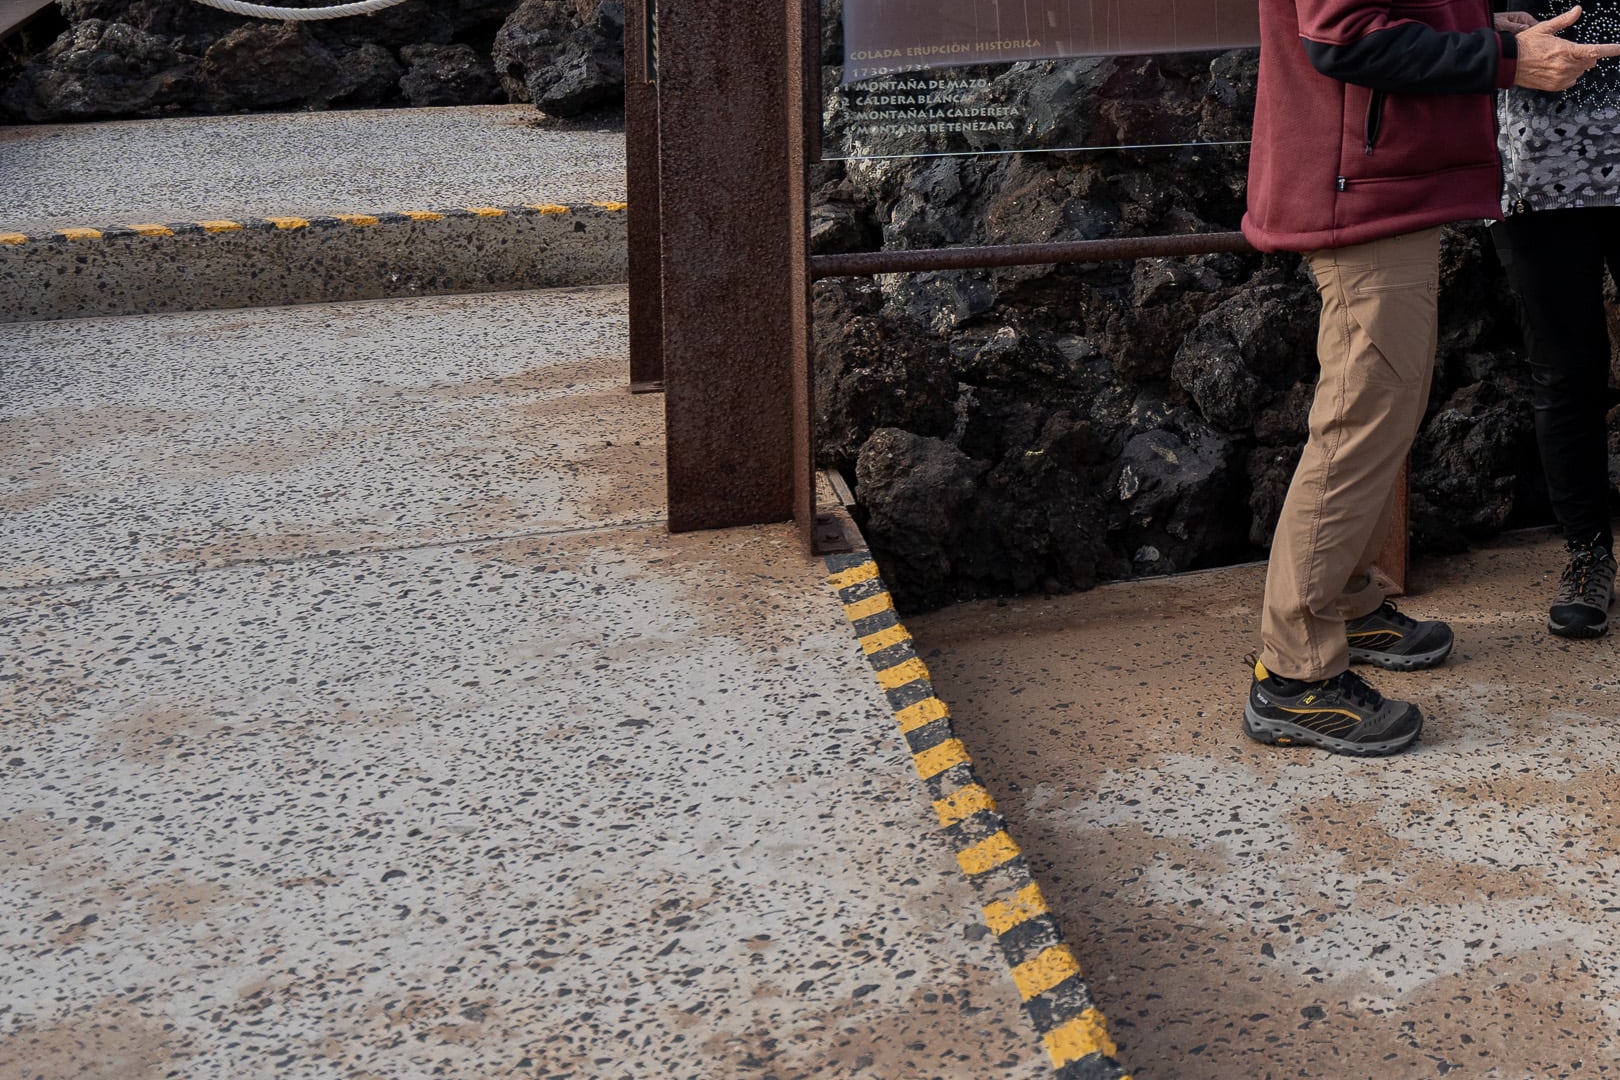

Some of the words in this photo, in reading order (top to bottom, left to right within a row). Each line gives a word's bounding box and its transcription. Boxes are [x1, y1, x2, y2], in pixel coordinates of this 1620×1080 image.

[850, 49, 902, 60] COLADA
[906, 42, 970, 57] ERUPCIÓN
[975, 39, 1041, 51] HISTÓRICA
[844, 82, 849, 92] 1
[855, 78, 927, 92] MONTAÑA
[929, 80, 945, 89] DE
[947, 78, 987, 88] MAZO
[843, 97, 850, 107] 2
[855, 95, 916, 106] CALDERA
[917, 94, 968, 104] BLANCA
[843, 111, 850, 121] 3
[856, 107, 927, 120] MONTAÑA
[929, 109, 945, 118] LA
[946, 106, 1019, 118] CALDERETA
[842, 126, 850, 136] 4
[929, 123, 945, 133] DE
[946, 120, 1015, 132] TENÉZARA
